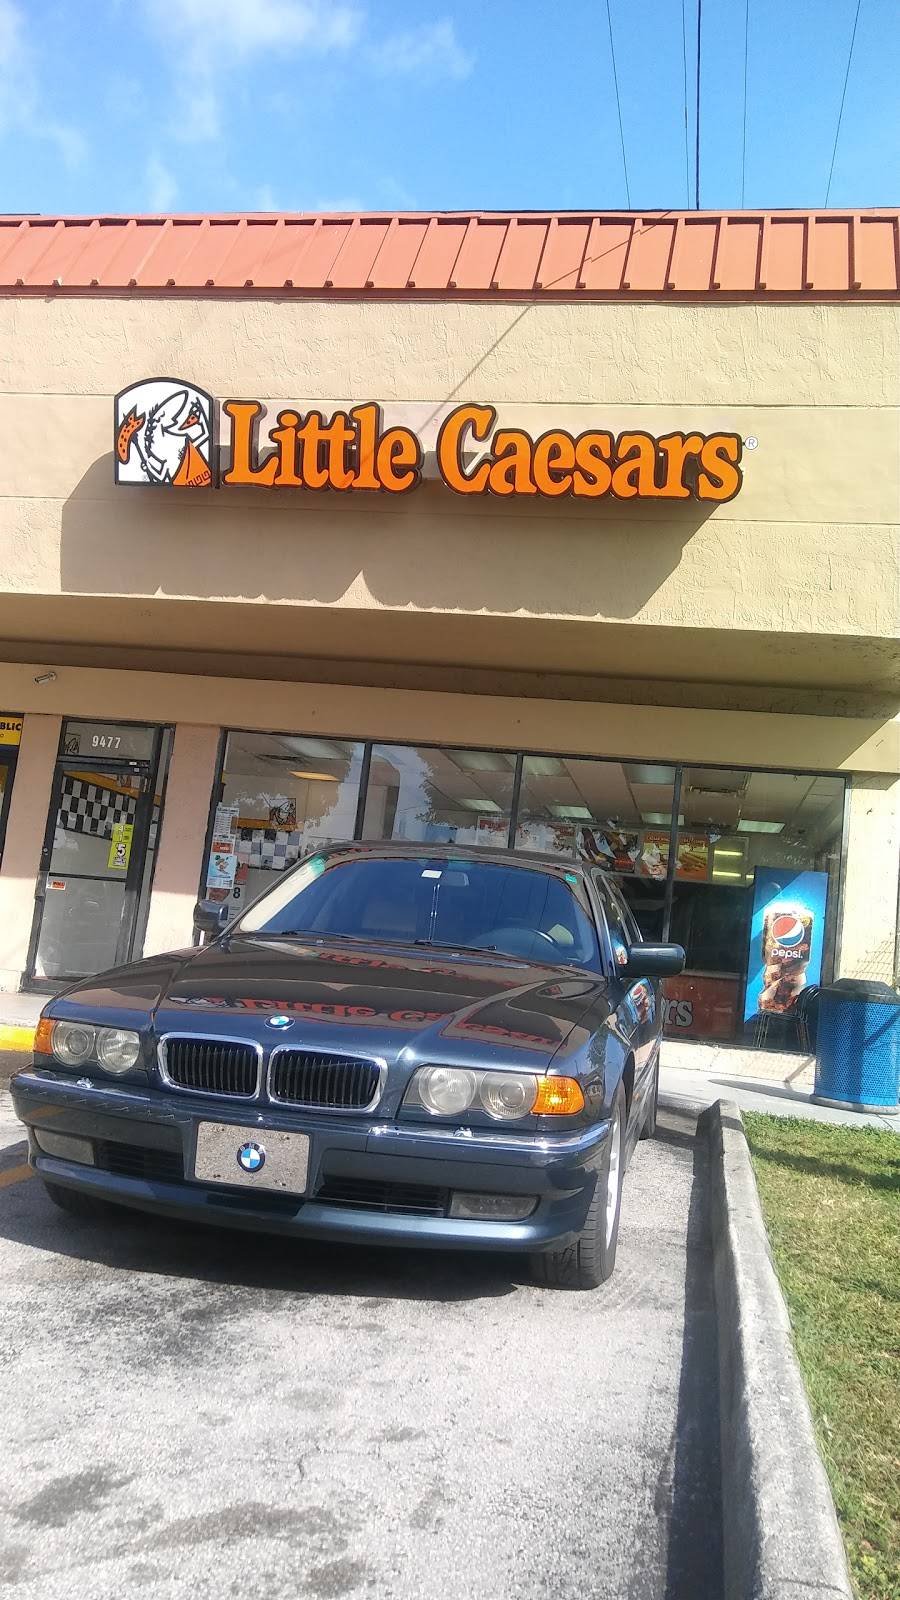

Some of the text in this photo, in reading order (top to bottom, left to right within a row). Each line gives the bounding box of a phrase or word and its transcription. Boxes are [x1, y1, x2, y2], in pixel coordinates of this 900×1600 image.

[223, 400, 422, 493] Little
[437, 403, 743, 503] Caesars
[92, 735, 121, 749] 9477
[233, 887, 241, 899] 8
